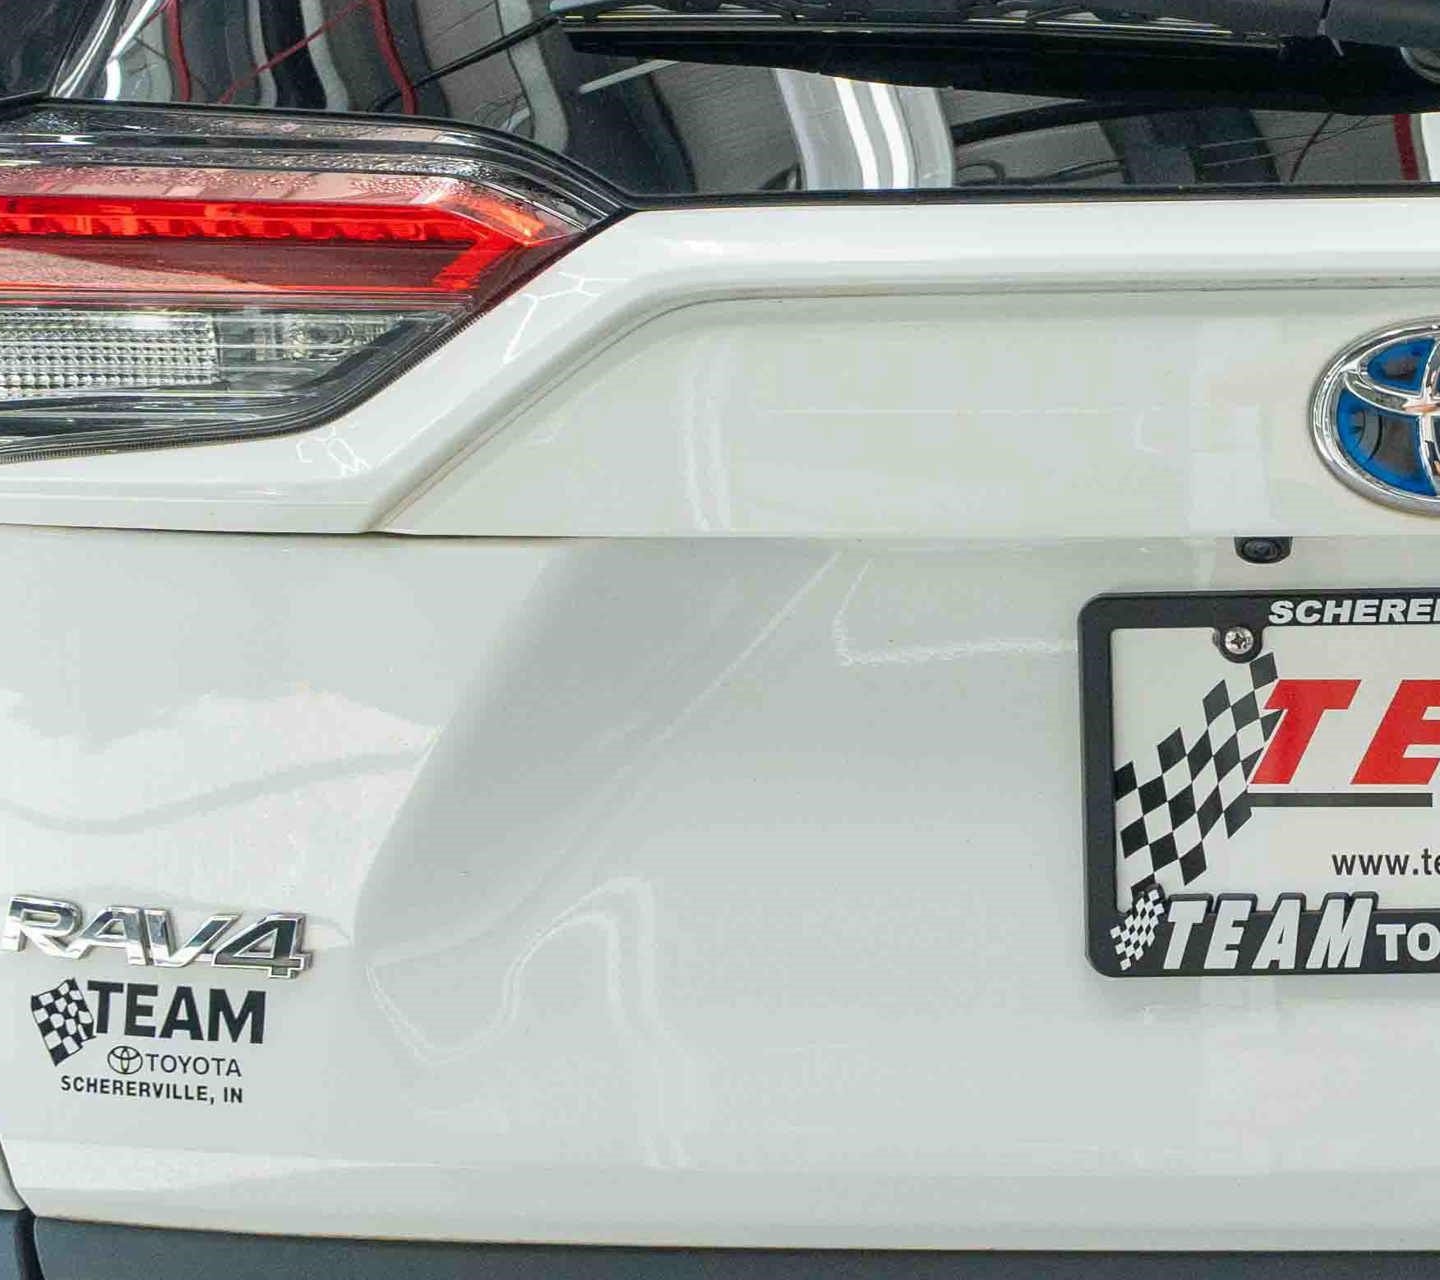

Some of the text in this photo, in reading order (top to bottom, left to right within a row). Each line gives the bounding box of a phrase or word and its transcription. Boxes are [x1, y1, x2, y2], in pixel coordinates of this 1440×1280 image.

[1, 895, 311, 979] RAV4
[1162, 896, 1376, 970] TEAM
[87, 979, 267, 1045] TEAM
[60, 1075, 244, 1105] SCHERERVILLE, IN
[145, 1053, 242, 1078] TOYOTA
